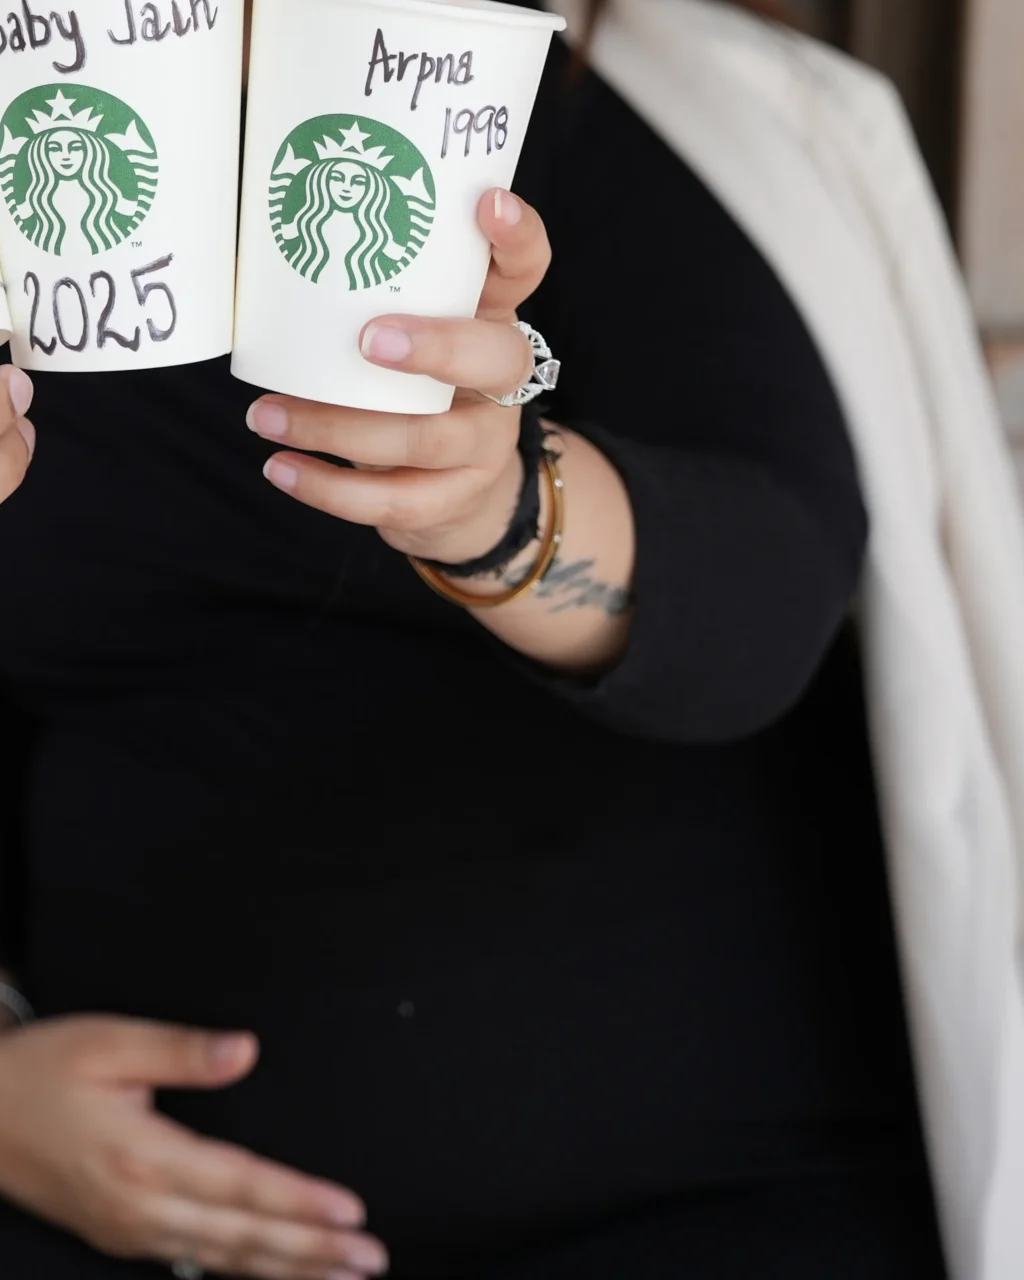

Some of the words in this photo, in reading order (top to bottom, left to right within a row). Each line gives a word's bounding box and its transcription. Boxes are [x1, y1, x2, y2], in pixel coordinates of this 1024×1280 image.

[364, 28, 475, 110] Arpna
[439, 105, 510, 159] 1998
[23, 253, 178, 357] 2025
